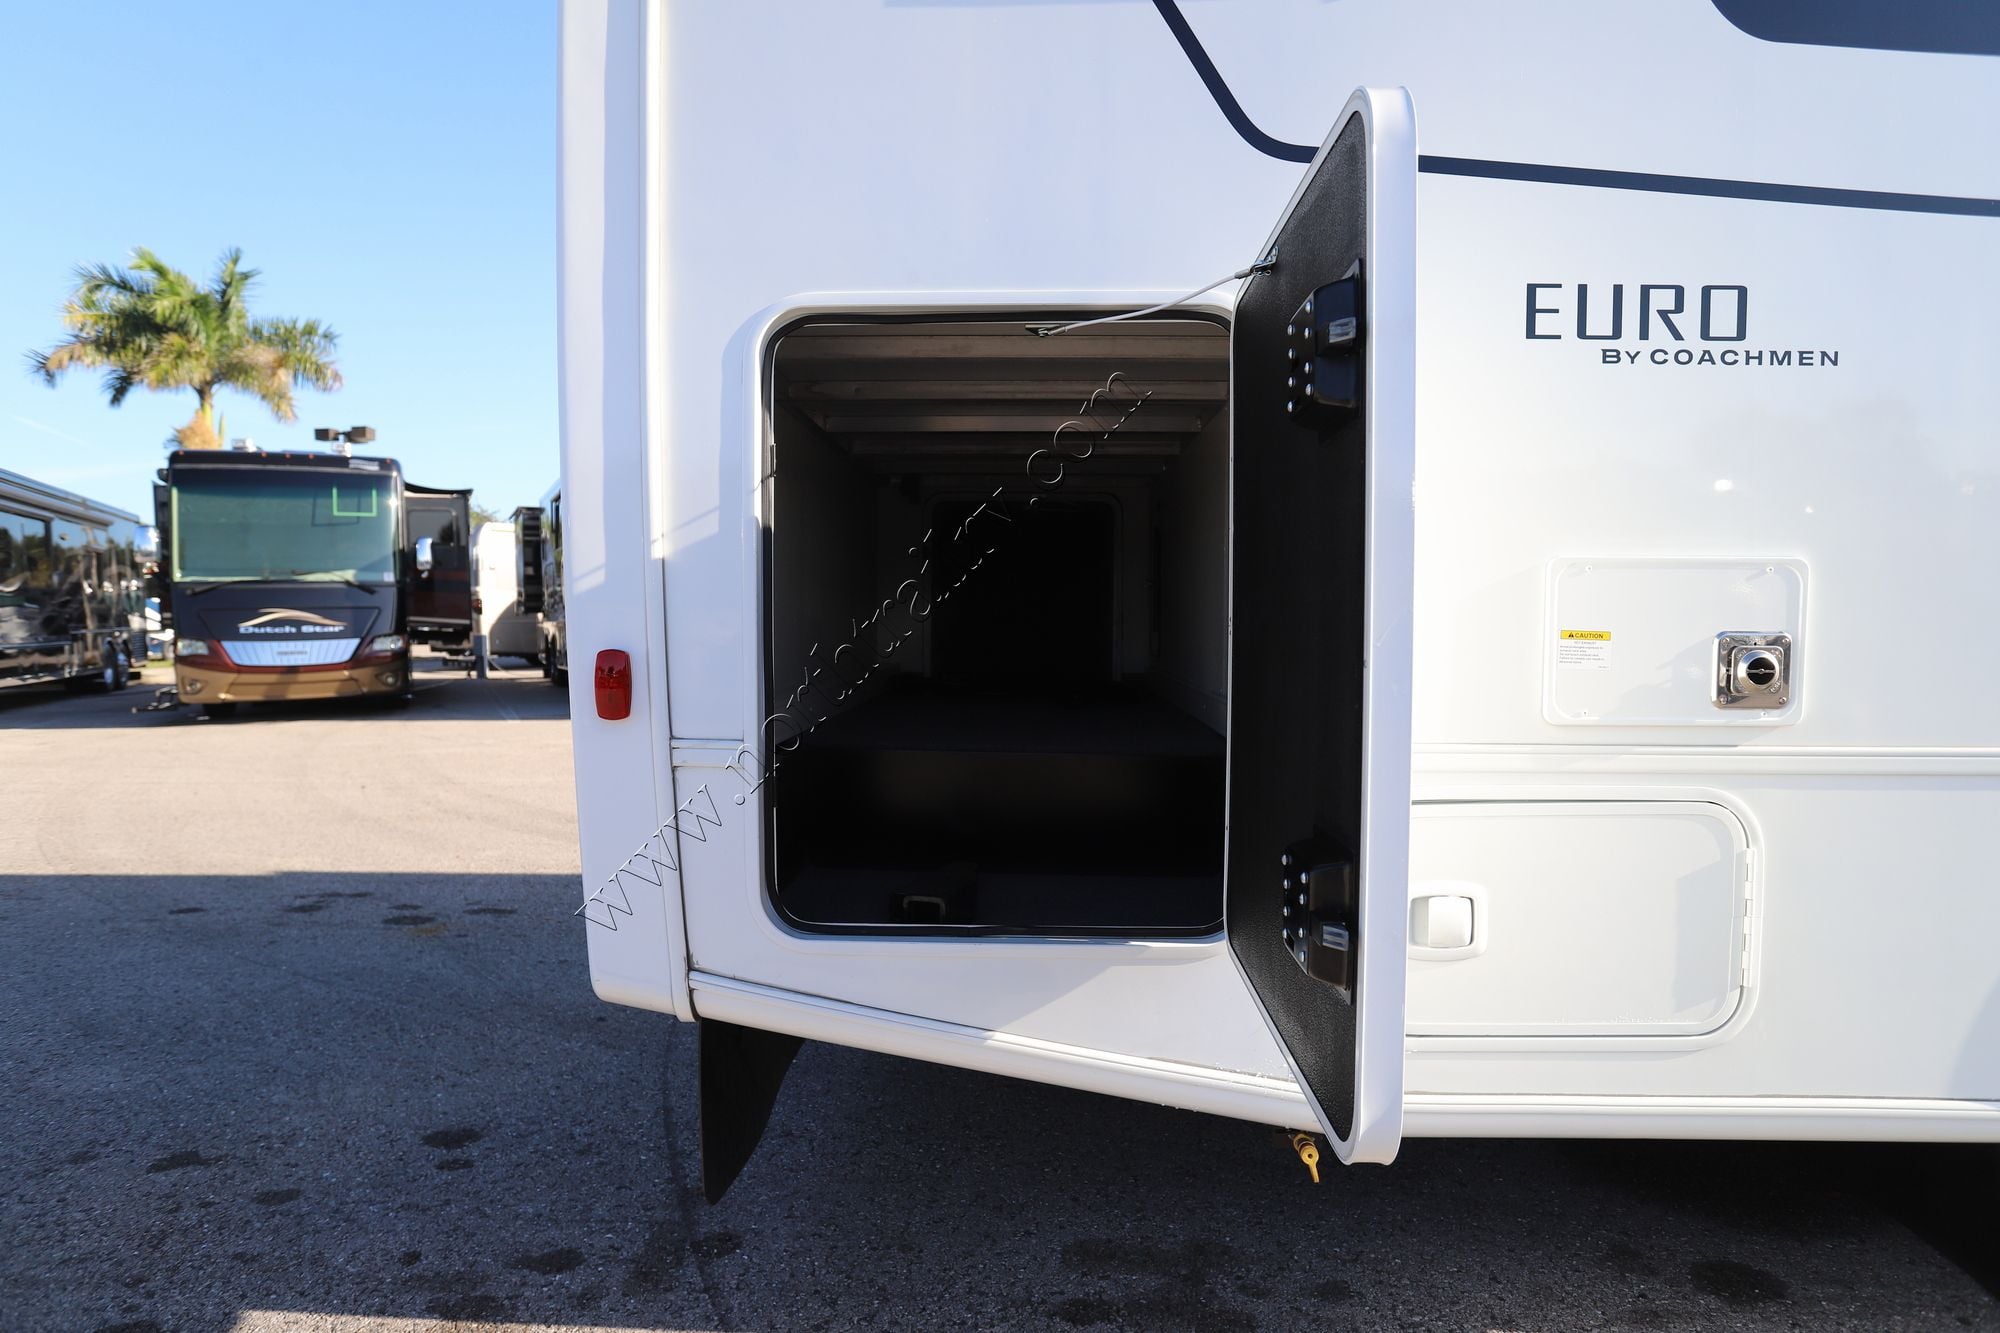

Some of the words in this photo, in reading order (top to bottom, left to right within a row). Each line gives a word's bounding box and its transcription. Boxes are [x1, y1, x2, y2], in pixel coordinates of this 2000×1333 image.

[1525, 283, 1748, 342] EURO
[1600, 348, 1641, 365] BY
[1649, 349, 1839, 367] COACHMEN
[238, 624, 297, 635] Dutch
[300, 623, 345, 634] Star
